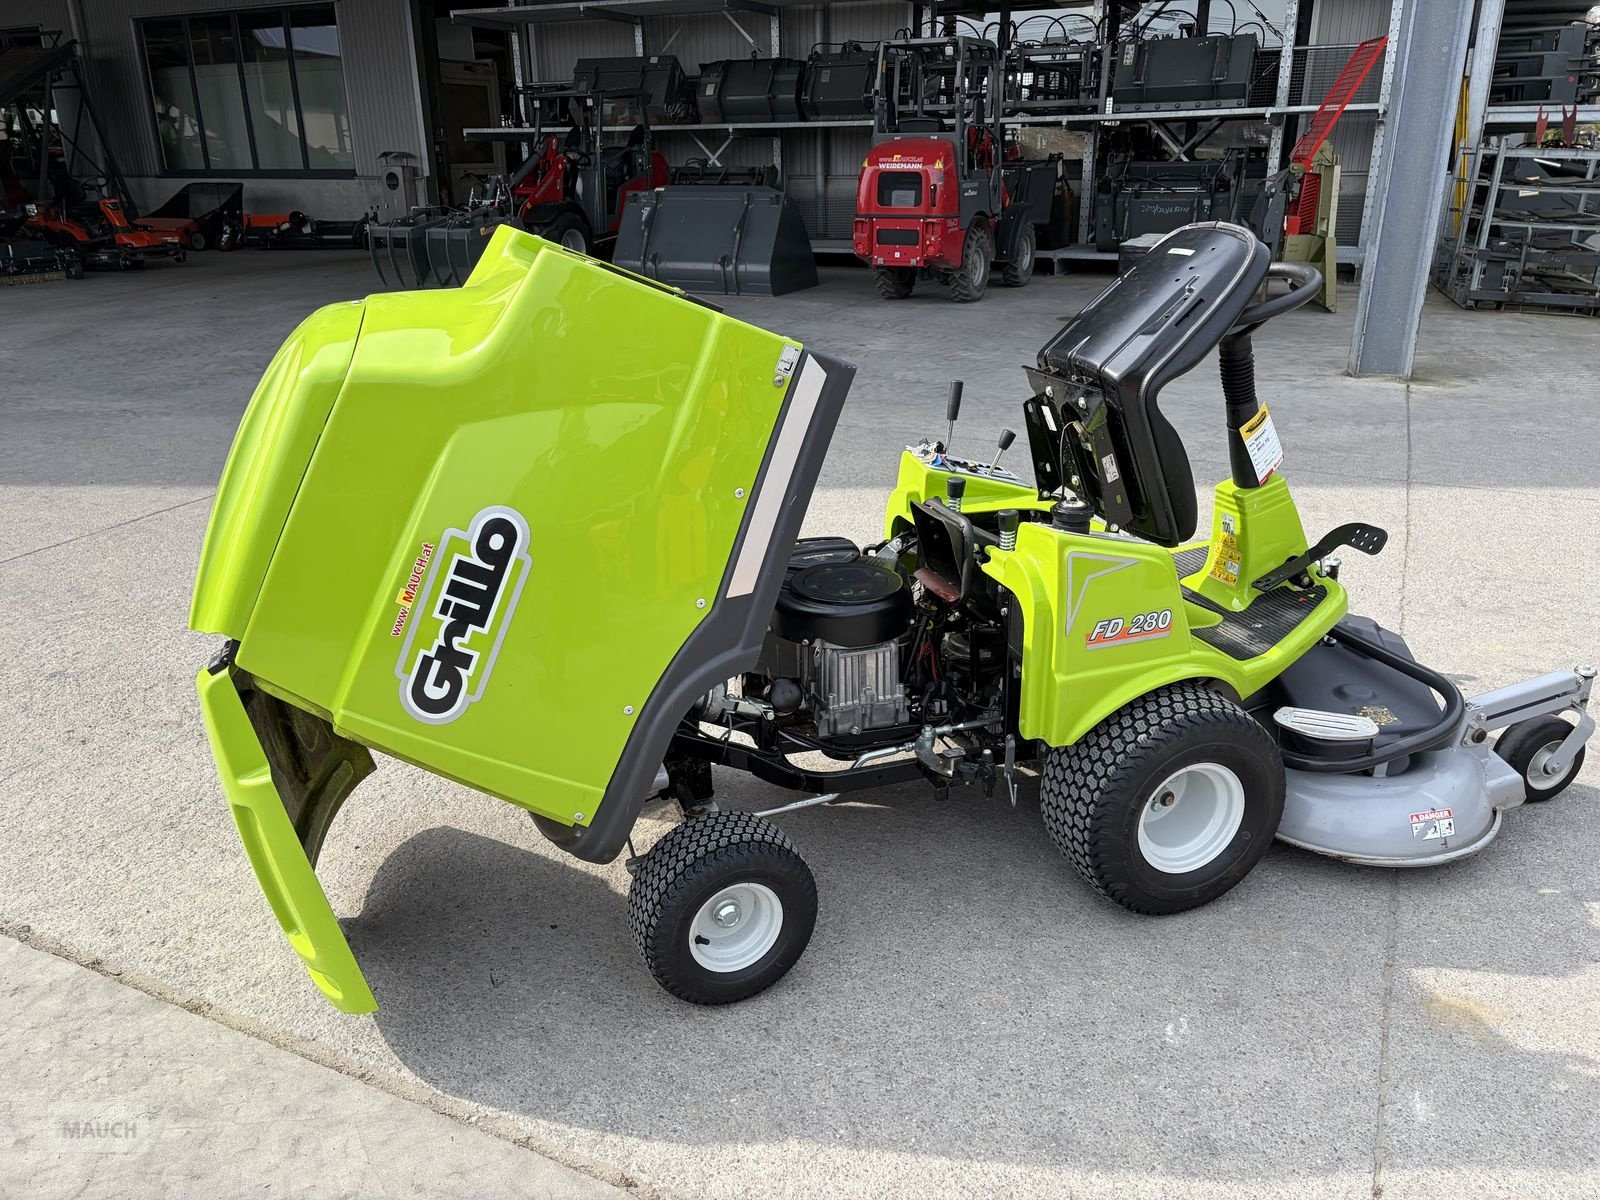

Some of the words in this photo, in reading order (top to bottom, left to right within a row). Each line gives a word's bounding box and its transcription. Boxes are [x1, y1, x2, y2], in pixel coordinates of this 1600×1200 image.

[410, 516, 519, 715] Grillo
[1088, 616, 1124, 641] FD
[1127, 608, 1172, 635] 280
[1418, 809, 1450, 822] DANGER
